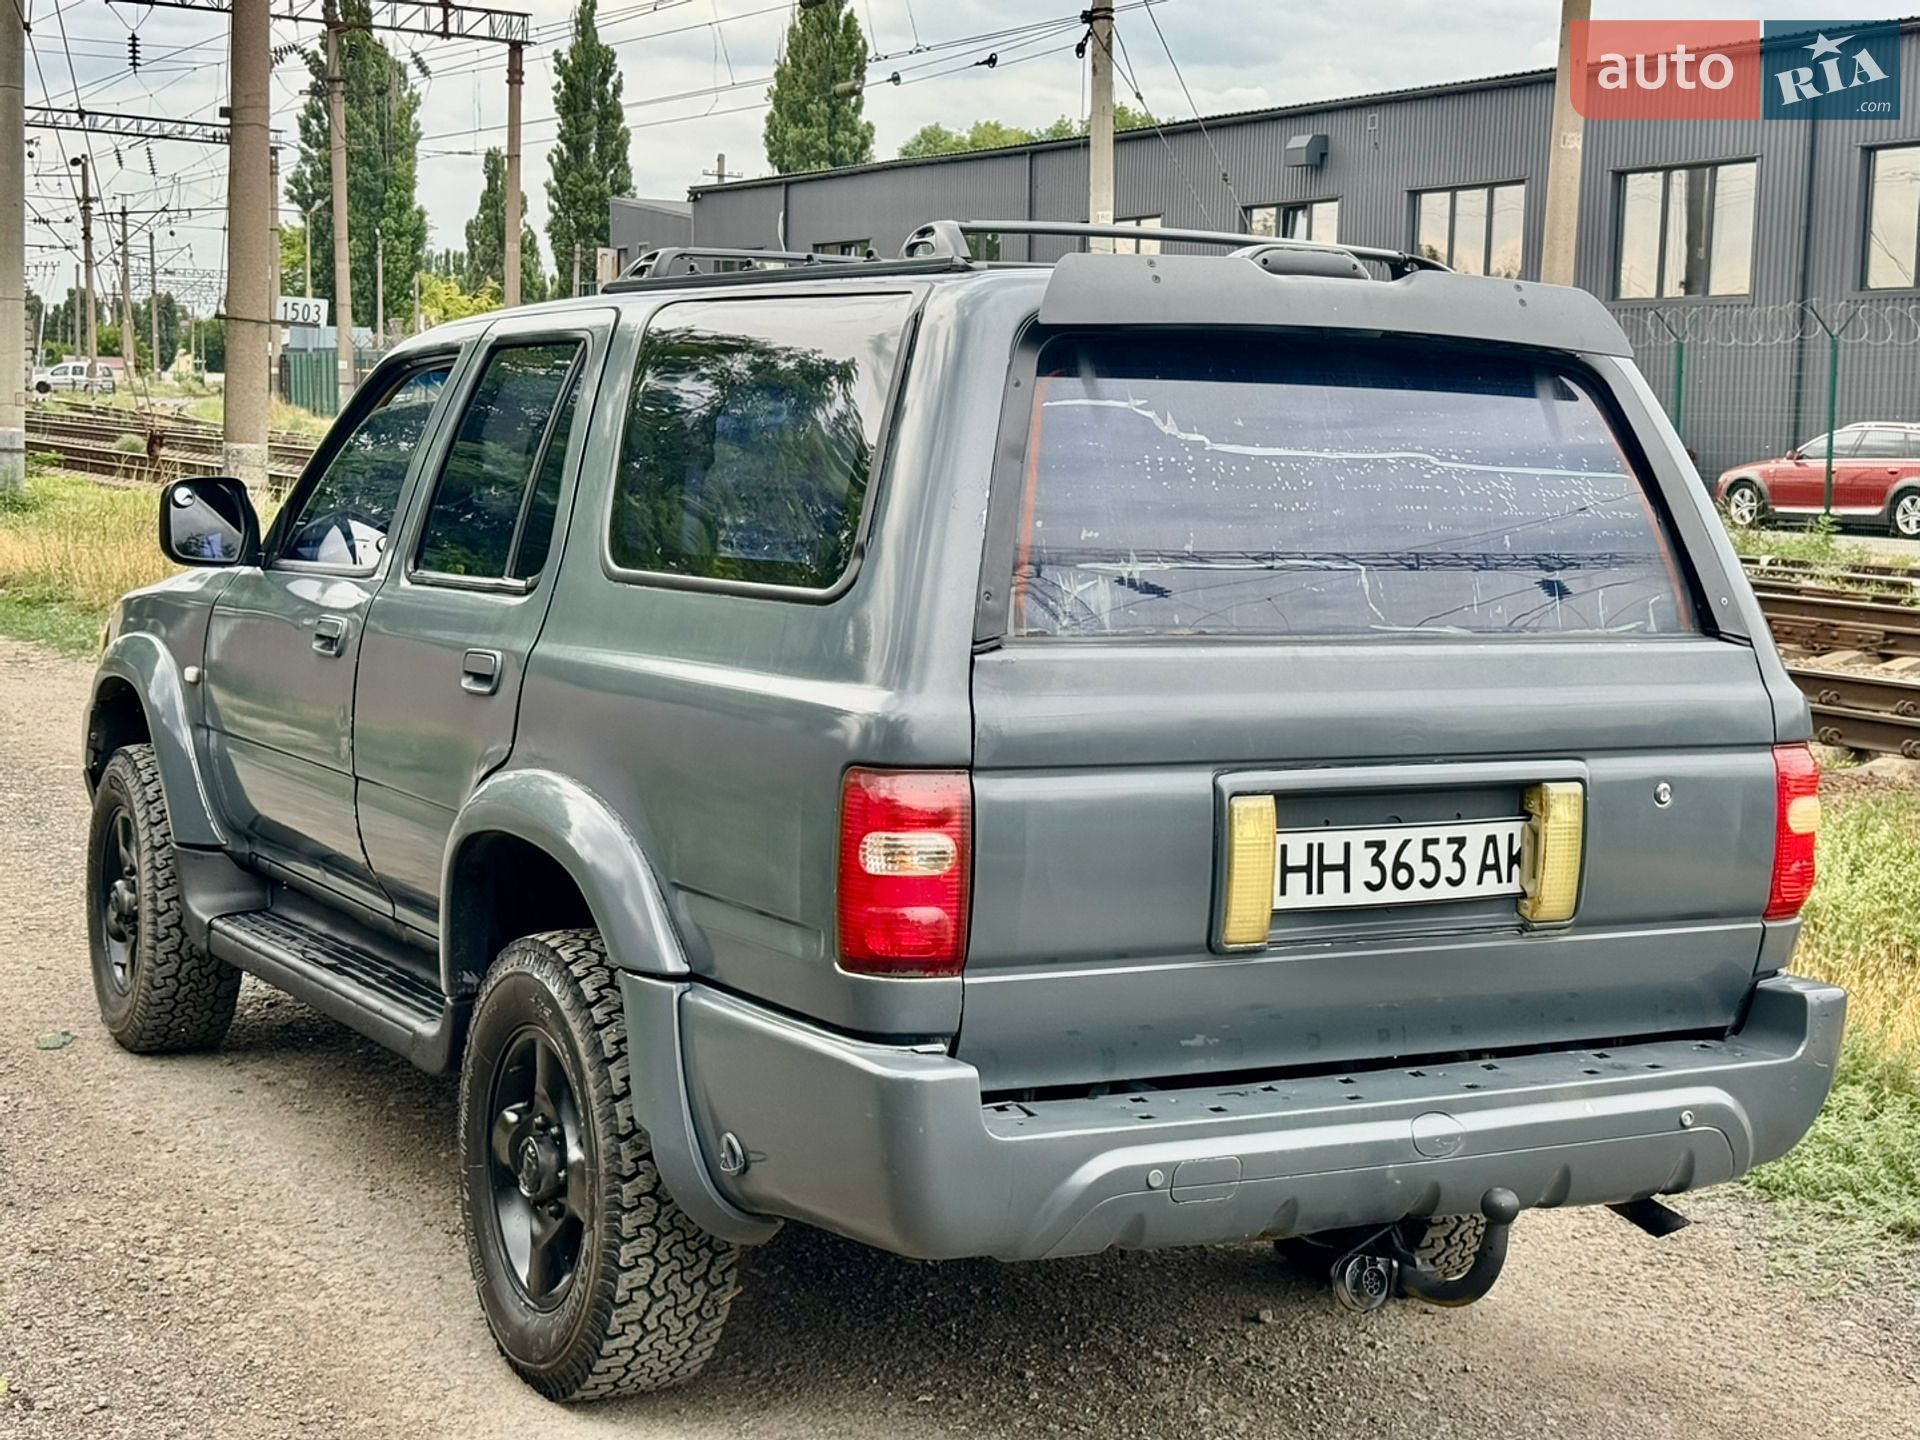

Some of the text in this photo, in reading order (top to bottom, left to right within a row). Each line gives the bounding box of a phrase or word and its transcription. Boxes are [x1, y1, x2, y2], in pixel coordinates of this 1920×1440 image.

[283, 302, 321, 323] 1503
[1279, 841, 1351, 897] HH
[1363, 836, 1467, 892] 3653
